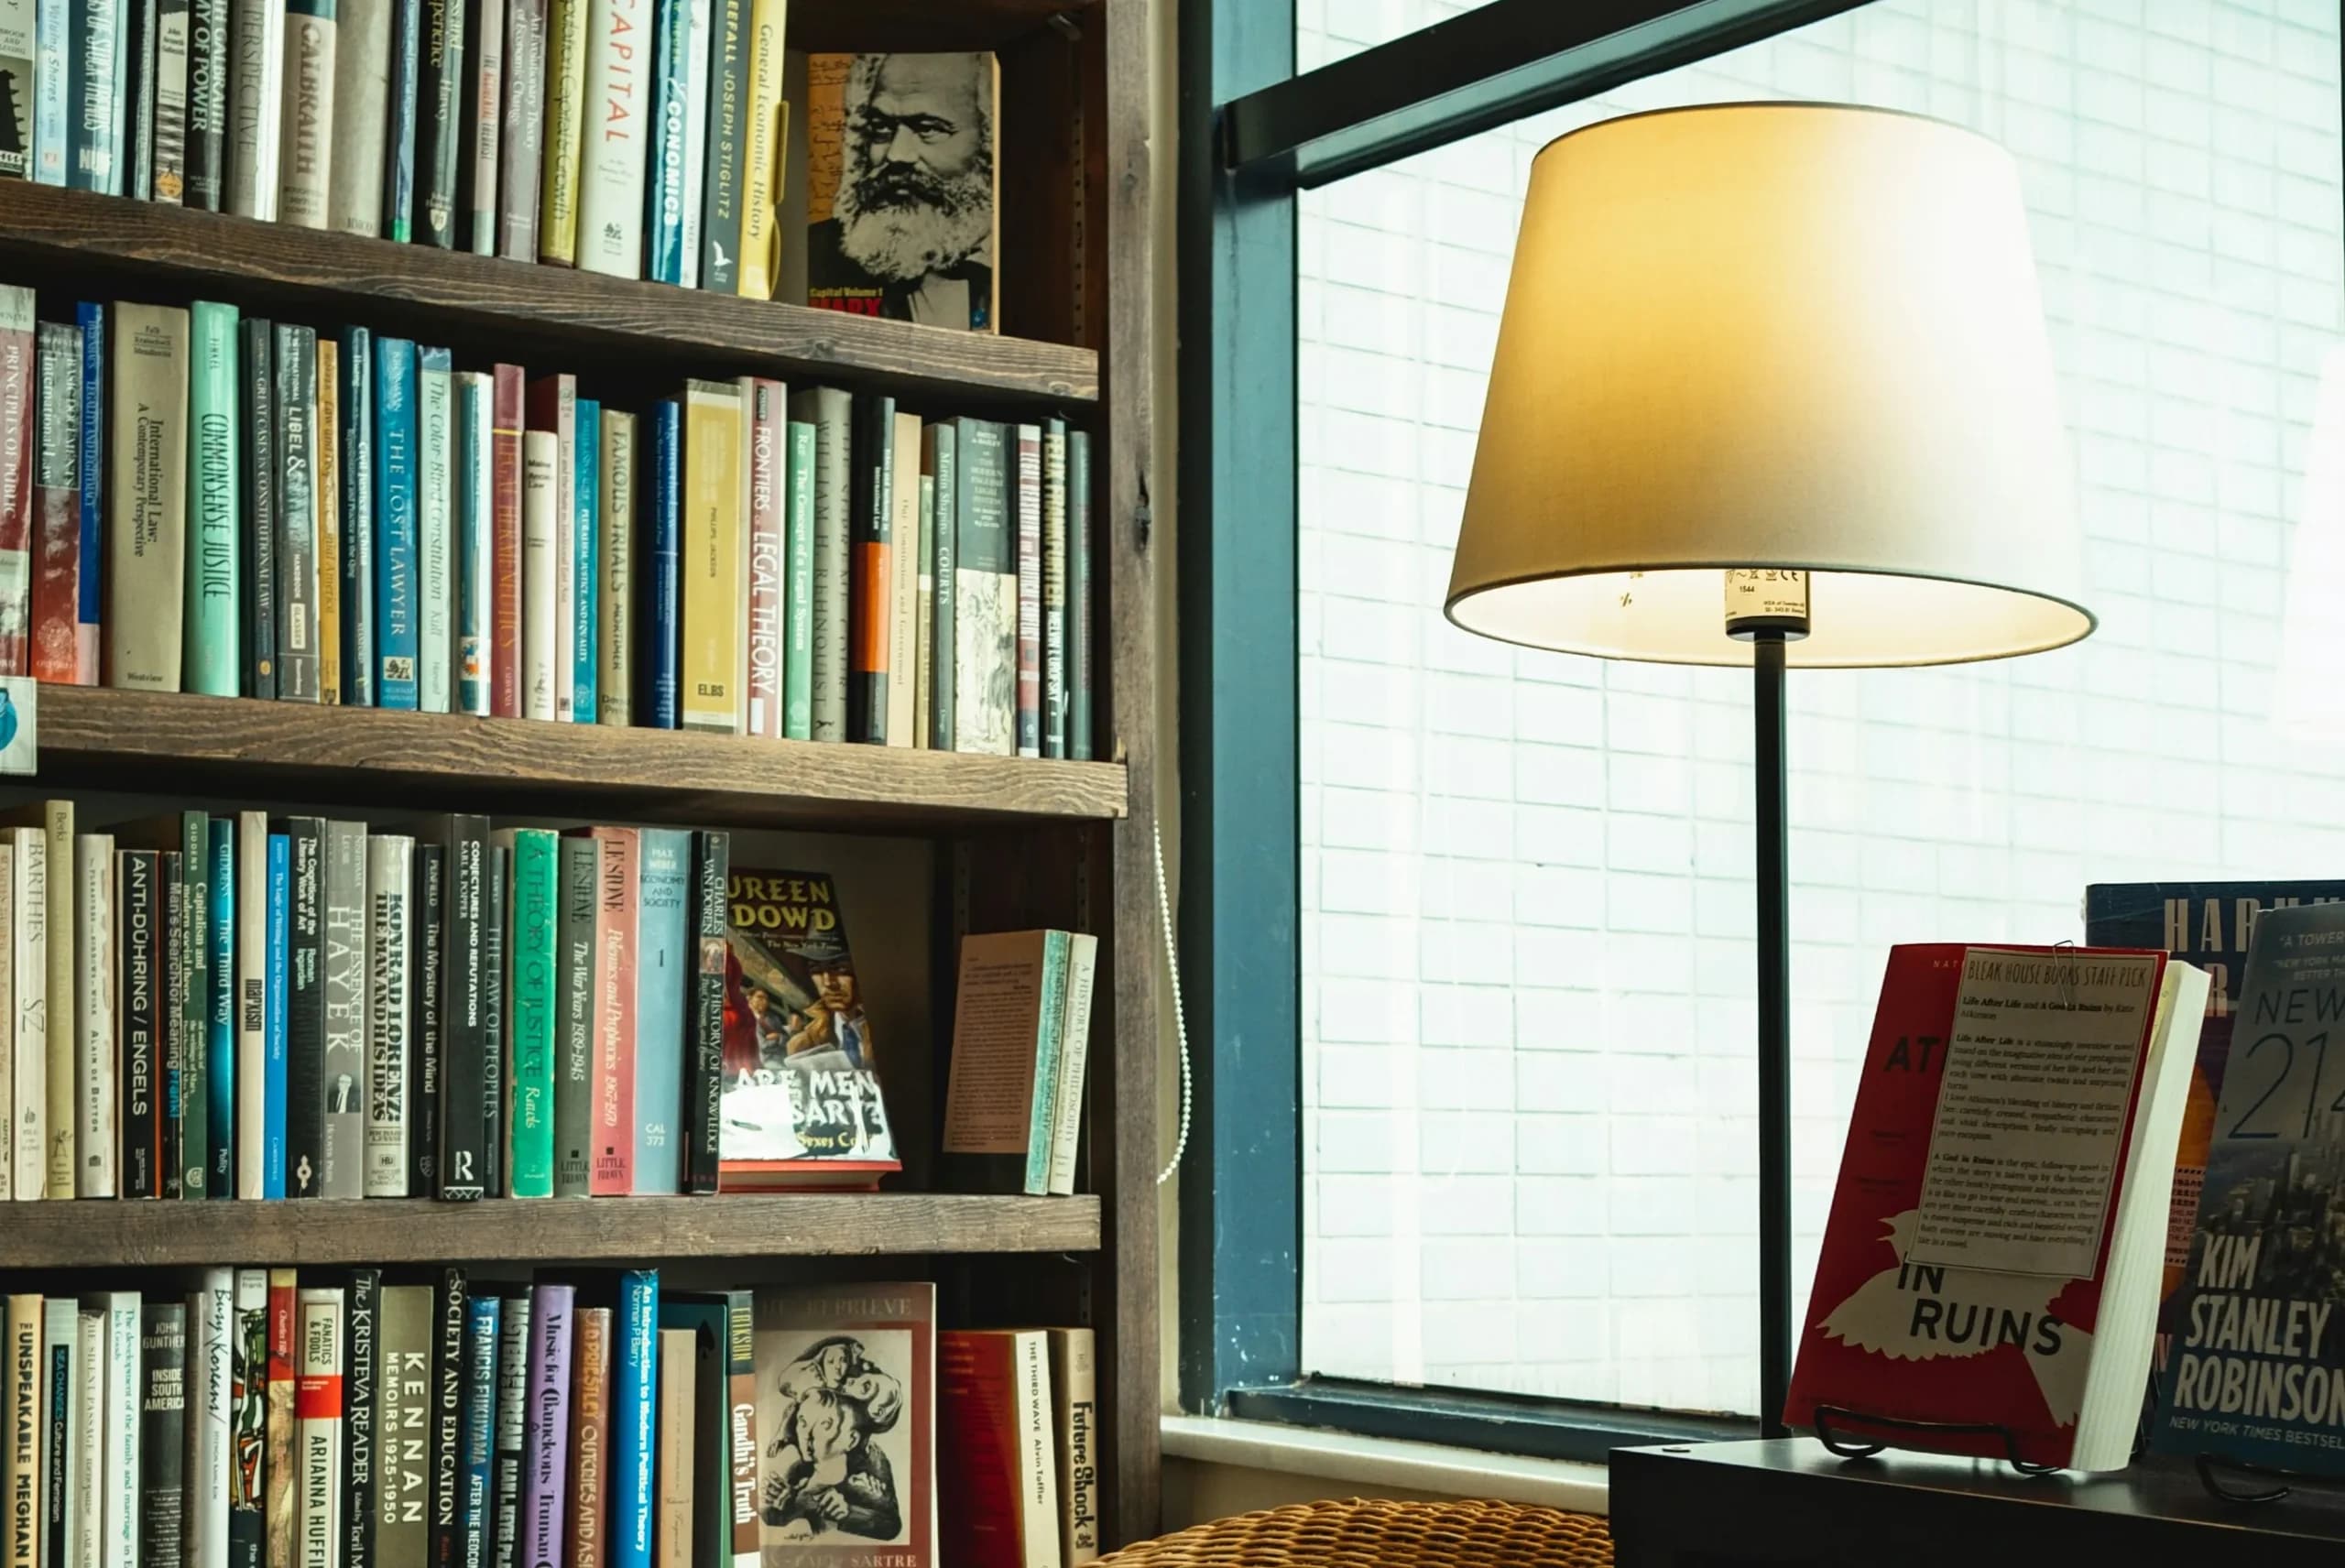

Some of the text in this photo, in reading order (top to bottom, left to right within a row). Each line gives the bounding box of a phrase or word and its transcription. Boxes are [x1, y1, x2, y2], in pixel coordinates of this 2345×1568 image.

[47, 57, 60, 103] Shares
[191, 27, 211, 131] OF POWER
[210, 28, 228, 134] GALBRAITH
[296, 22, 322, 176] GALBRAITH
[435, 79, 452, 122] Harvey
[722, 70, 736, 136] JOSEPH
[747, 24, 774, 242] General Economic History
[716, 141, 734, 220] STIGLITZ
[286, 406, 307, 474] LIBEL &
[1045, 433, 1065, 479] FELIX
[147, 419, 164, 543] International Law:
[202, 413, 231, 600] COMMONSENSE JUSTICE
[388, 429, 407, 636] THE LOST LAWYER
[610, 430, 629, 671] FAMOUS TRIALS MORTIMER
[751, 426, 779, 695] FRONTIERS LEGAL THEORY
[935, 452, 952, 605] Martin Shapiro COURTS
[697, 683, 725, 697] ELBS
[55, 811, 69, 842] Berki
[27, 843, 45, 942] BARTHES
[191, 882, 209, 969] Capitalism and
[220, 916, 233, 945] The
[572, 876, 594, 924] STONE
[703, 858, 714, 935] VAN DOREN
[714, 877, 726, 935] CHARLES
[734, 904, 836, 931] DOWD
[132, 856, 151, 1011] ANTI-DÜHRING
[218, 951, 233, 988] Third
[294, 947, 307, 990] Ingarden
[305, 947, 317, 983] Roman
[467, 840, 482, 1028] CONJECTURES AND REFUTATIONS
[214, 993, 232, 1026] Way
[245, 978, 264, 1032] marxism
[326, 906, 352, 1056] HAYEK
[348, 906, 364, 1055] THE ESSENCE OF
[373, 891, 389, 1122] THE MAN AND HIS IDEAS
[387, 893, 404, 1122] KONRAD LORENZ:
[423, 859, 442, 1094] PENFIELD The Mystery of the Mind
[570, 941, 589, 1081] The War Years 1939-1945
[1962, 996, 2021, 1008] Life After Life
[1967, 960, 2147, 988] BLEAK HOUSE BOOKS STAFF PICK
[2254, 988, 2345, 1025] NEW
[91, 1030, 101, 1064] ALAIN
[483, 924, 501, 1119] THE LAW OF PEOPLES
[131, 1029, 149, 1116] ENGELS
[1063, 977, 1090, 1144] HISTORY OF PHILOSOPHY
[90, 1086, 101, 1134] BOTTON
[645, 1125, 665, 1135] CAL
[2198, 1234, 2263, 1290] KIM
[143, 1335, 184, 1350] GUNTHER
[154, 1322, 178, 1334] JOHN
[309, 1330, 322, 1364] FOOLS
[321, 1318, 334, 1367] FANATICS
[628, 1284, 643, 1368] Norman Barry
[731, 1307, 753, 1362] ERIKSON
[1910, 1300, 2062, 1356] RUINS
[2184, 1293, 2332, 1360] STANLEY
[144, 1396, 184, 1411] AMERICA
[151, 1368, 182, 1382] INSIDE
[151, 1382, 182, 1397] SOUTH
[349, 1276, 372, 1486] The KRISTEVA READER
[438, 1279, 464, 1526] SOCIETY AND EDUCATION
[2173, 1353, 2345, 1428] ROBINSON
[15, 1332, 35, 1558] UNSPEAKABLE MEGHAN
[383, 1352, 398, 1525] MEMOIRS 1925-1950
[401, 1351, 426, 1523] KENNAN
[469, 1316, 494, 1529] FRANCIS FUKUYAMA AFTER THE
[537, 1312, 563, 1559] Music for Chameleons Truman
[577, 1341, 600, 1537] PRIESTLEY OUTCRIES AND
[635, 1284, 654, 1553] An Introduction to Modern Political Theory
[2169, 1416, 2200, 1430] NEW
[2202, 1420, 2240, 1435] YORK
[2243, 1424, 2282, 1440] TIMES
[308, 1435, 328, 1509] ARIANNA
[732, 1402, 759, 1525] Gandhi's Truth
[1072, 1400, 1096, 1530] Future Shock
